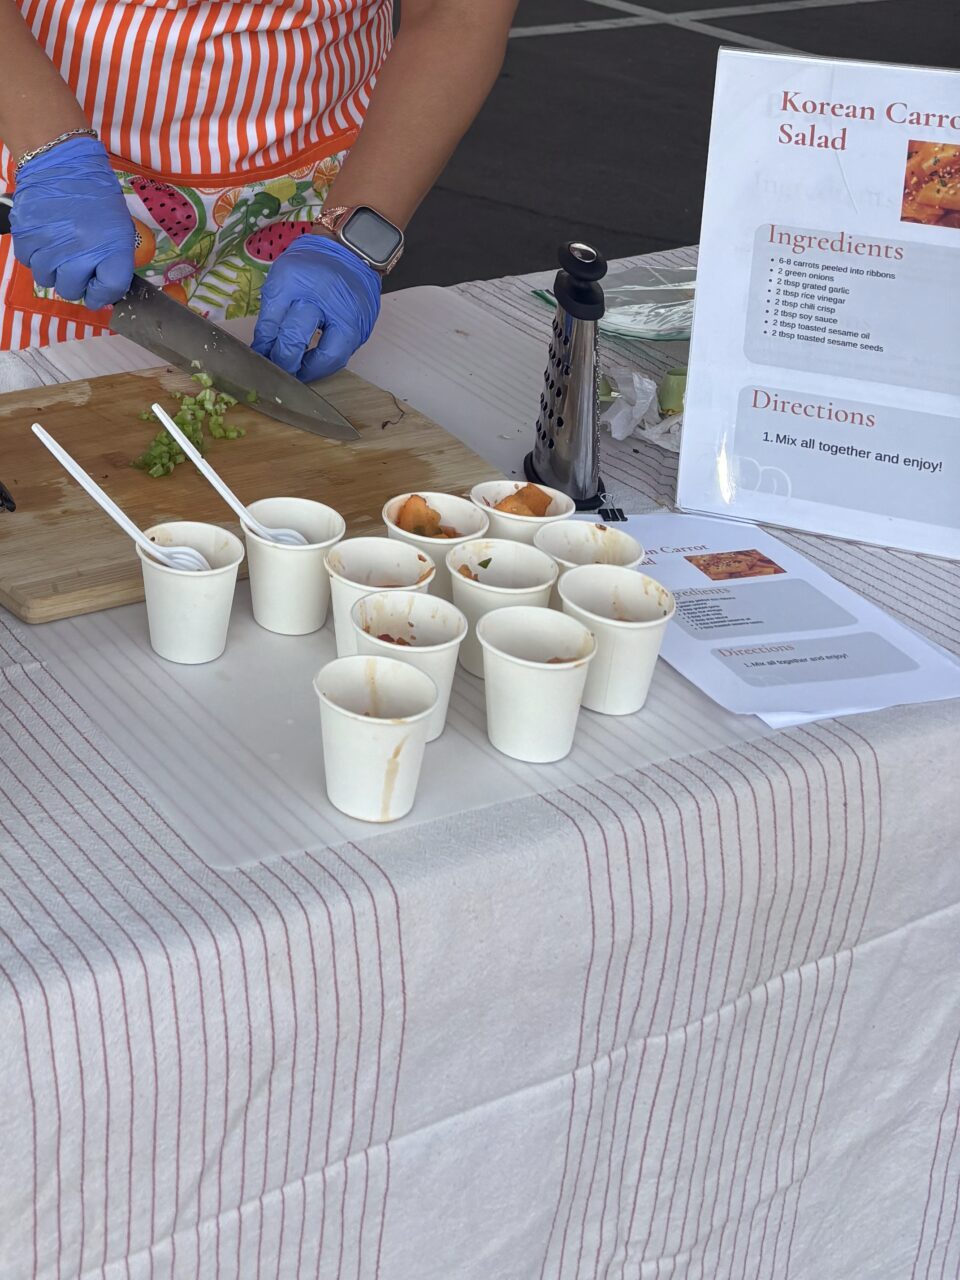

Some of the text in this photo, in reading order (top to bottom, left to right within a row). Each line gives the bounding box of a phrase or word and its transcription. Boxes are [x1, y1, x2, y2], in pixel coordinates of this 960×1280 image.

[780, 90, 875, 121] Korean
[778, 123, 847, 151] Salad
[768, 224, 904, 261] Ingredients
[778, 257, 896, 280] 6-8 carrots peeled into ribbons
[784, 269, 807, 278] green
[808, 272, 834, 282] onions
[784, 279, 800, 288] tbsp
[802, 282, 826, 291] grated
[828, 285, 850, 295] garlic
[783, 289, 799, 298] tbsp
[801, 292, 815, 300] rice
[817, 294, 846, 305] vinegar
[782, 300, 798, 309] tbsp
[800, 302, 815, 310] chili
[817, 305, 836, 314] crisp
[781, 310, 797, 319] tbsp
[799, 313, 813, 322] soy
[814, 316, 838, 324] sauce
[780, 320, 796, 329] tbsp
[798, 322, 826, 333] toasted
[828, 328, 859, 338] sesame
[779, 331, 795, 340] tbsp
[797, 333, 825, 343] toasted
[827, 338, 858, 348] sesame
[860, 343, 884, 352] seeds
[752, 388, 875, 428] Directions
[762, 431, 943, 473] 1. Mix all together and enjoy!
[660, 544, 710, 554] Carrot
[672, 587, 731, 600] gredients
[719, 644, 795, 657] Directions
